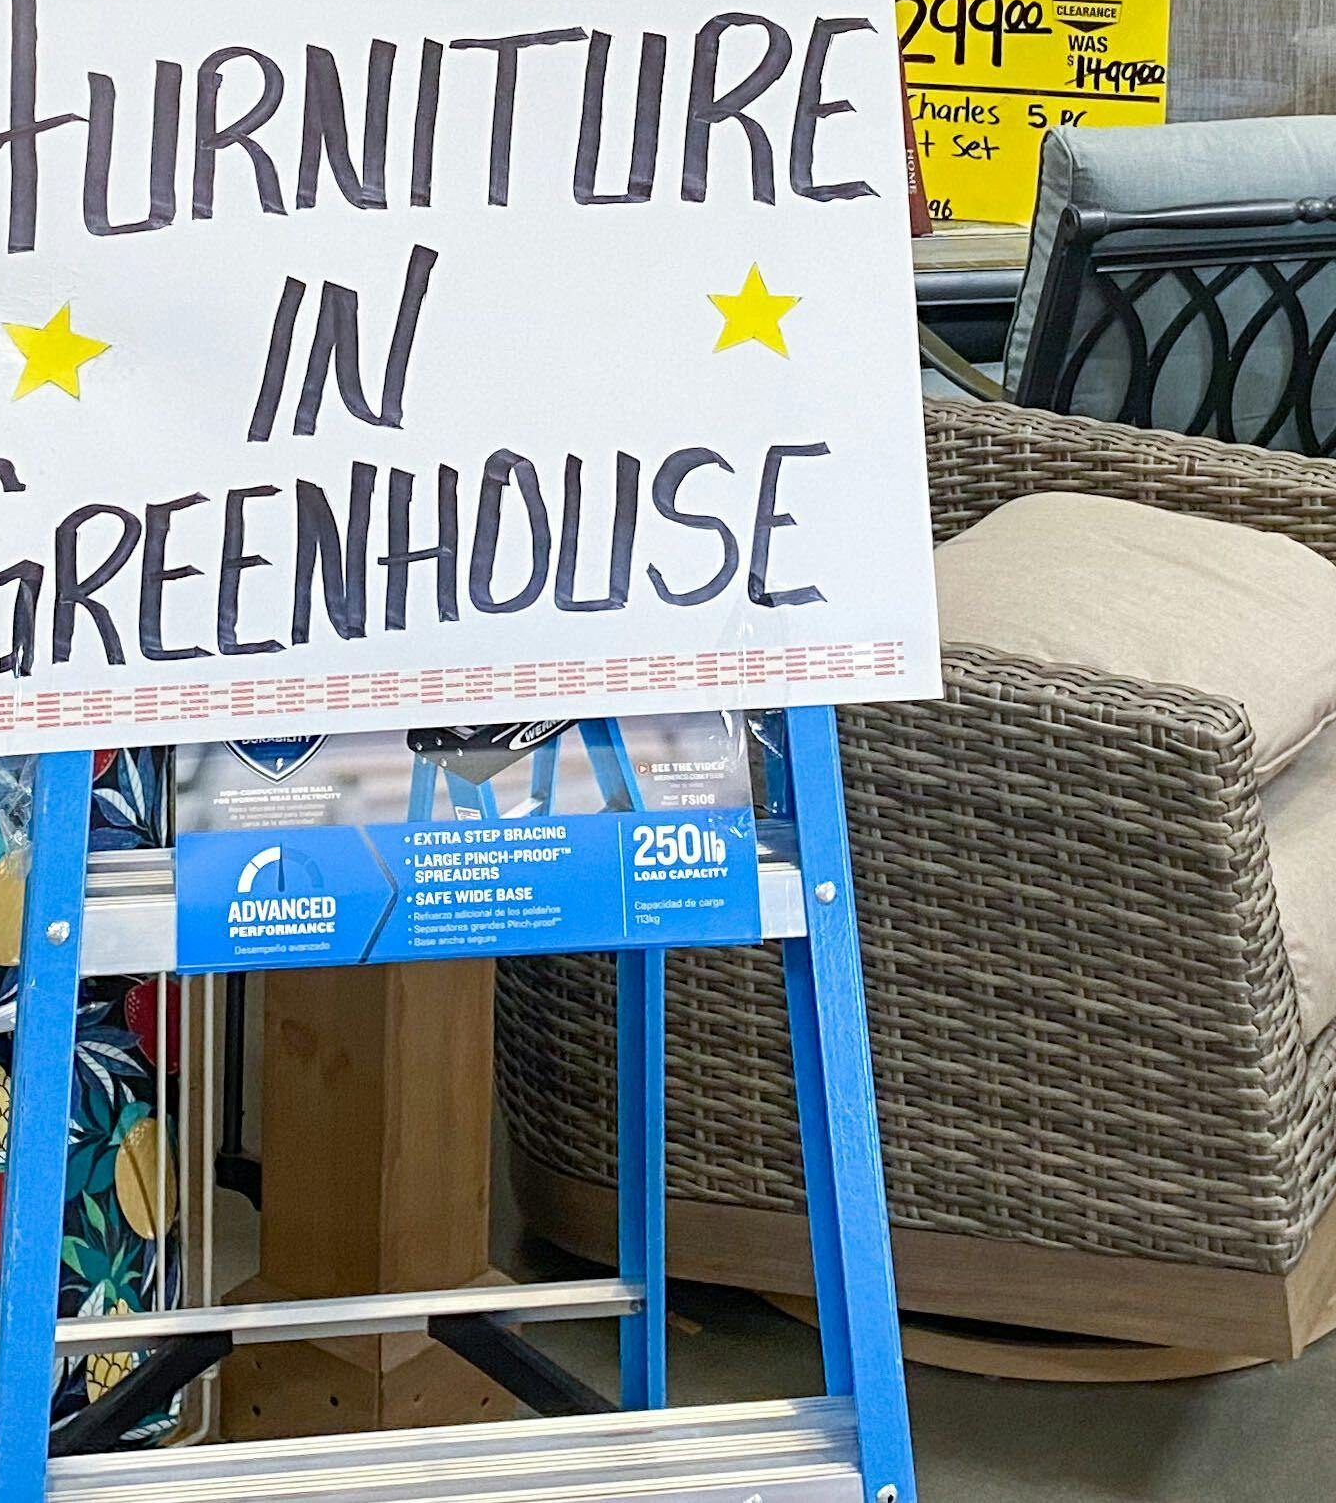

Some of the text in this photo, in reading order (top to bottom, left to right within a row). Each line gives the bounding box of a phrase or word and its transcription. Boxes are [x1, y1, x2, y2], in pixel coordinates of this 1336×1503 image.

[1056, 5, 1117, 19] CLEARANCE
[1067, 35, 1108, 53] WAS
[1028, 104, 1048, 128] 5
[952, 134, 1001, 161] Set
[906, 148, 918, 194] HOME
[247, 245, 438, 441] IN
[651, 761, 726, 772] SEE THE VIDEO
[414, 826, 567, 846] EXTRA STEP BRACING
[415, 853, 462, 867] LARGE
[415, 867, 500, 884] SPREADERS
[634, 867, 729, 881] LOAD CAPACITY
[415, 887, 534, 906] SAFE WIDE BASE
[228, 896, 337, 924] ADVANCED
[229, 922, 336, 938] PERFORMANCE
